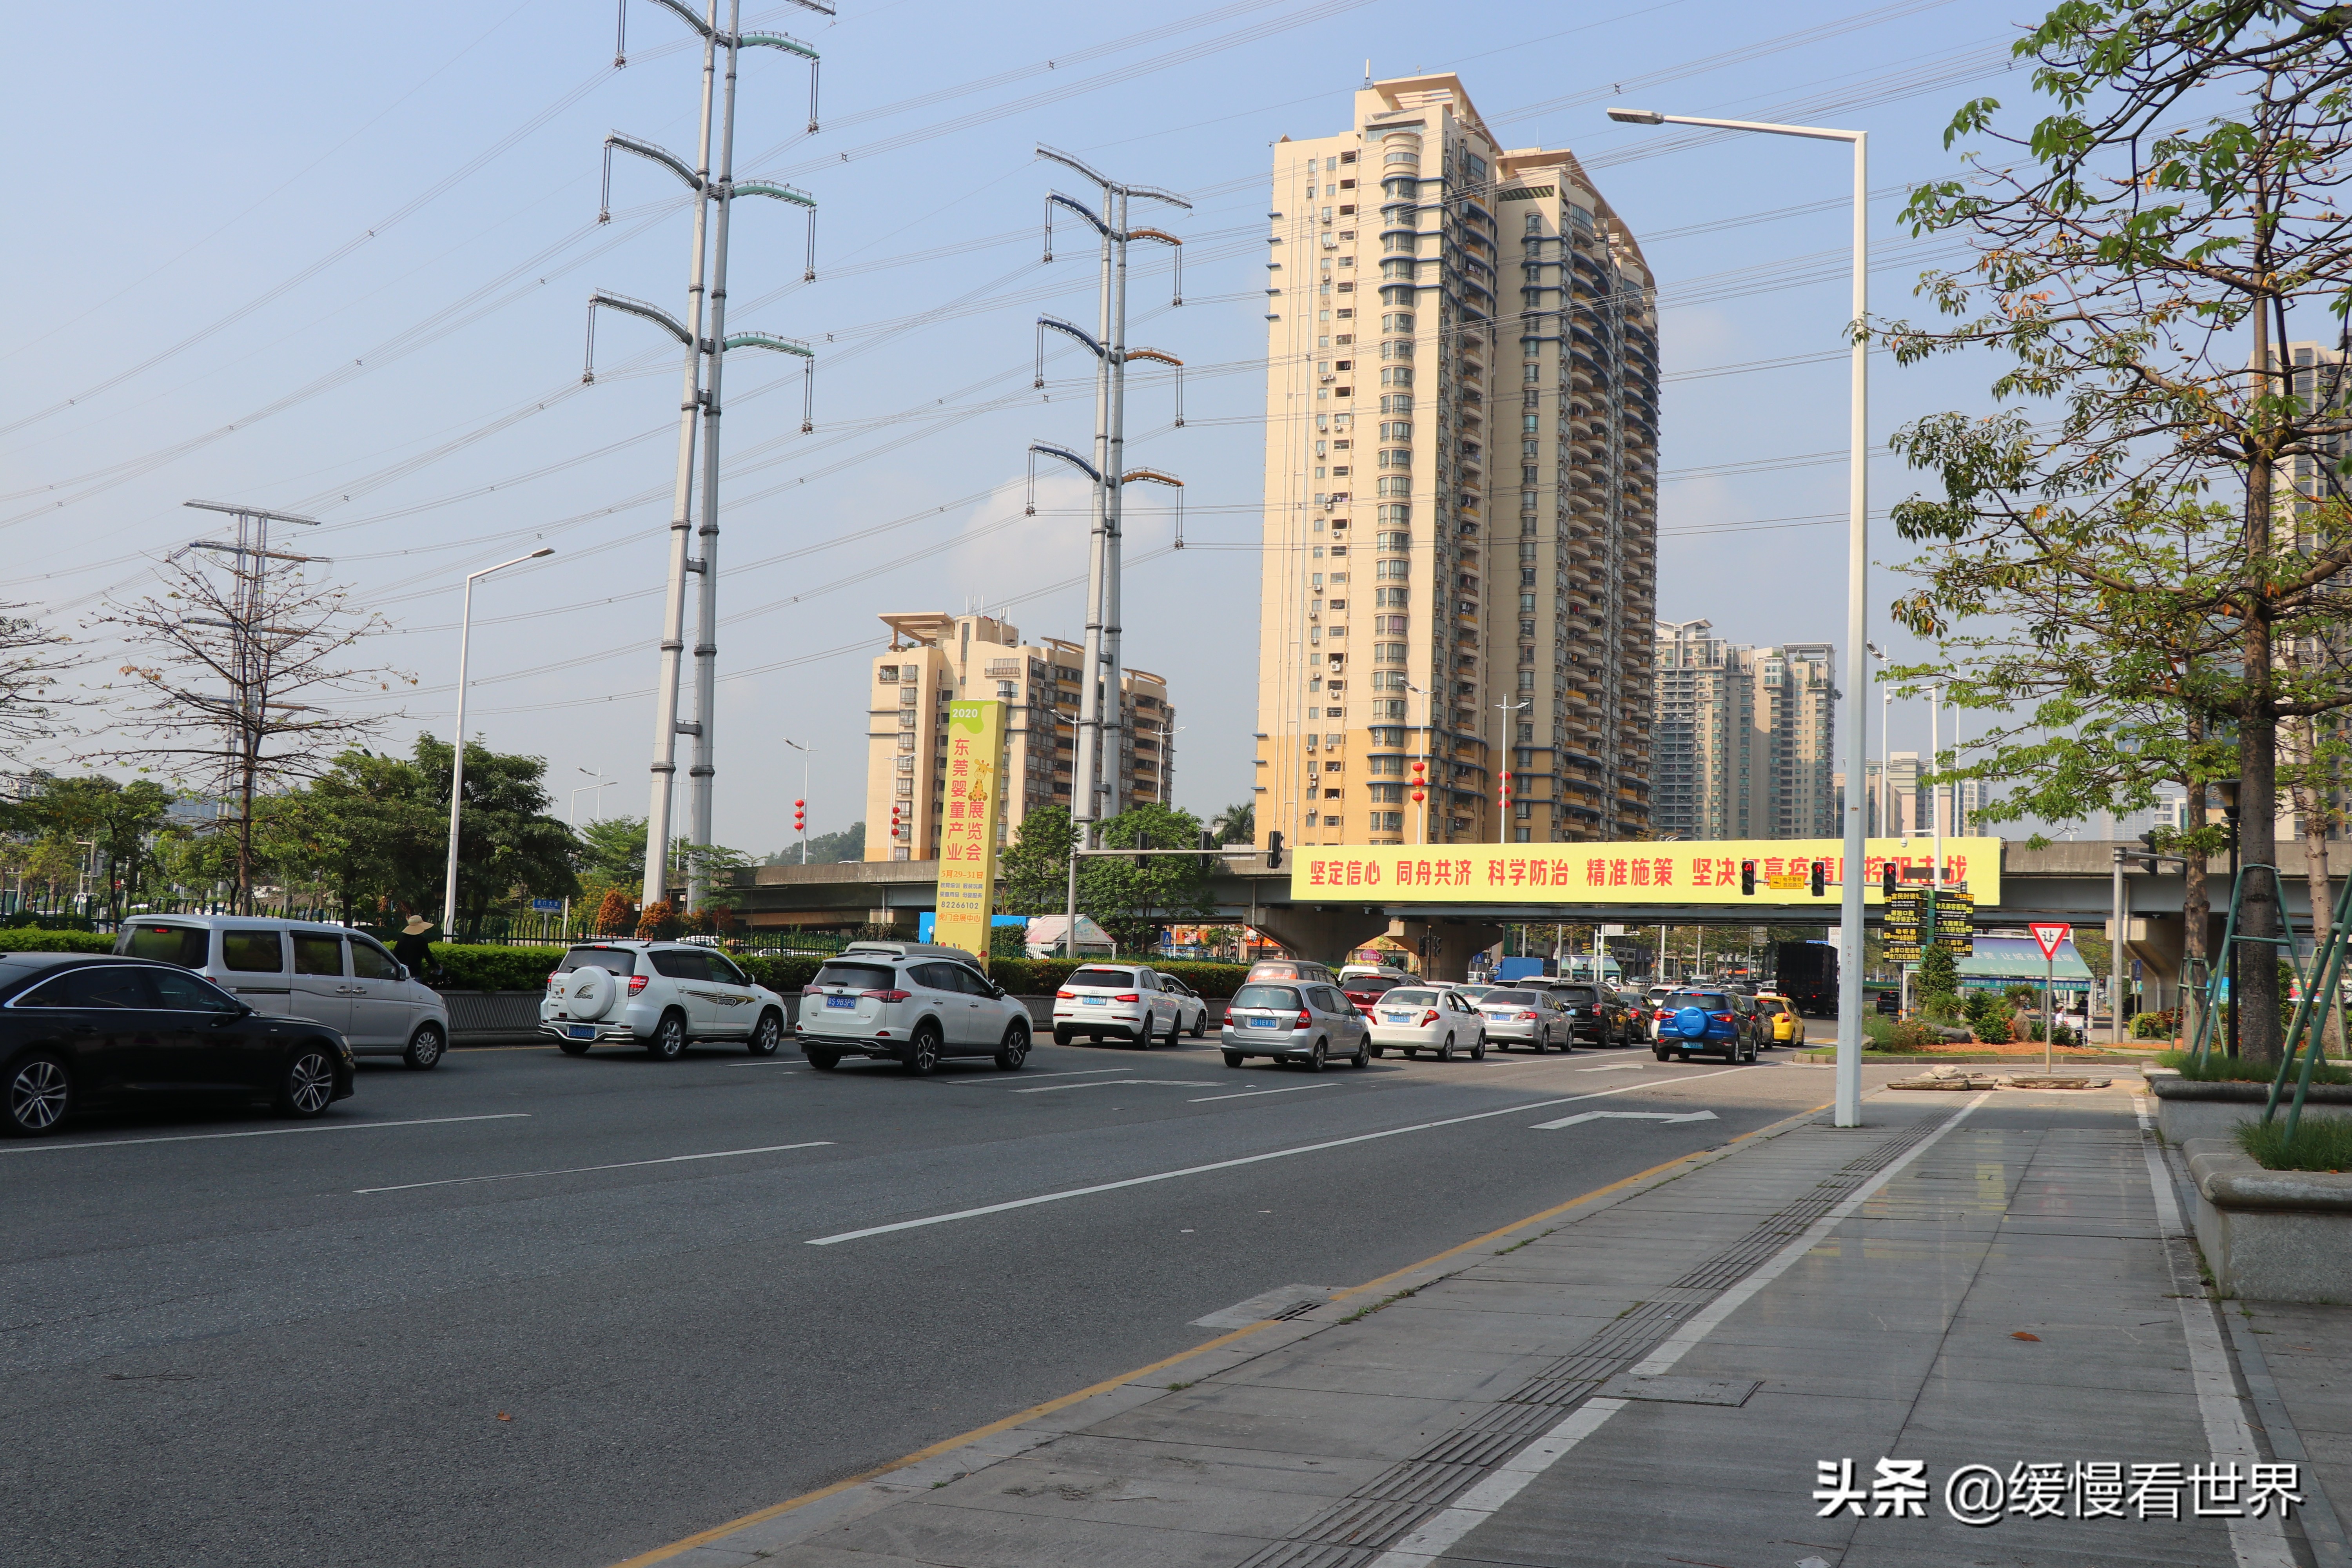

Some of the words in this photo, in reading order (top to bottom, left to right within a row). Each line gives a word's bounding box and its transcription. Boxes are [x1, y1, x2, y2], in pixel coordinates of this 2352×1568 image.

[952, 708, 978, 718] 2020
[946, 738, 970, 861] 东莞婴童产业
[966, 801, 984, 862] 展览会
[1310, 860, 1381, 886] 坚定信心
[1396, 860, 1472, 886] 同舟共济
[1488, 859, 1569, 887] 科学防治
[1587, 858, 1673, 887] 精准施策
[938, 913, 981, 922] 虎门会展中心
[2042, 930, 2054, 942] 让
